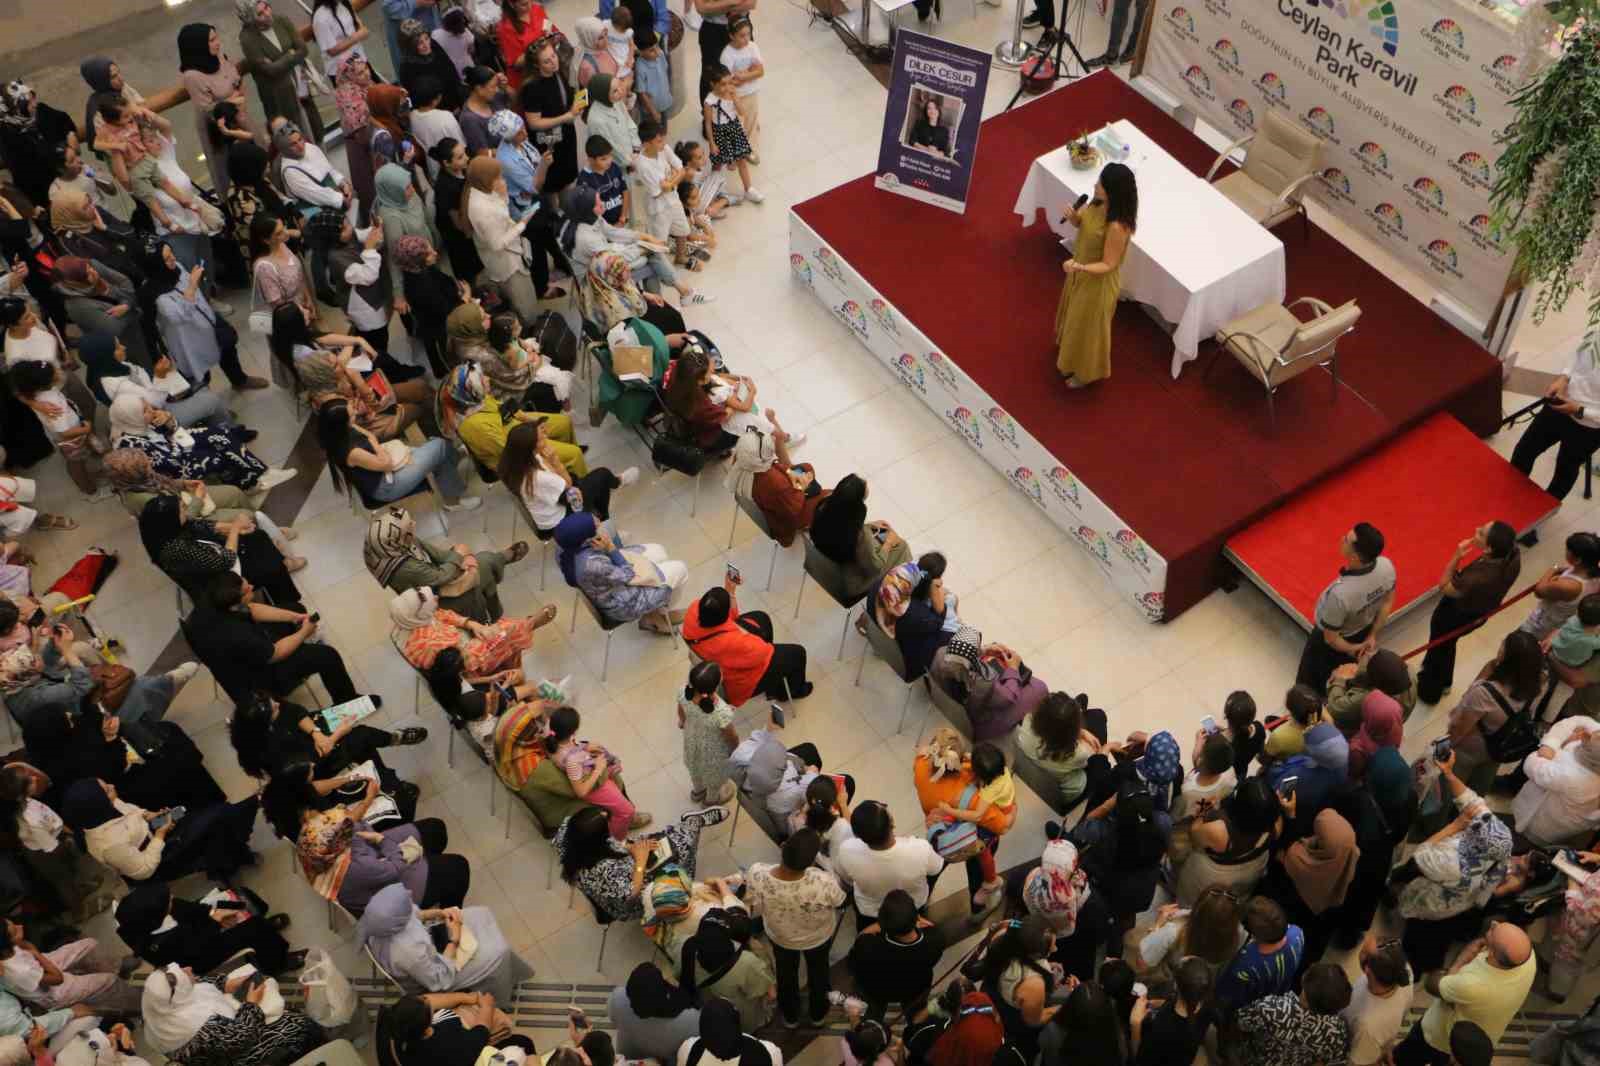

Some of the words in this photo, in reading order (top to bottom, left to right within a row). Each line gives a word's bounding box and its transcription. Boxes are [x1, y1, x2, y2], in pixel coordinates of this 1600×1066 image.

[1278, 0, 1342, 51] Ceylan
[1346, 38, 1418, 96] Karavil
[1316, 45, 1360, 88] Park
